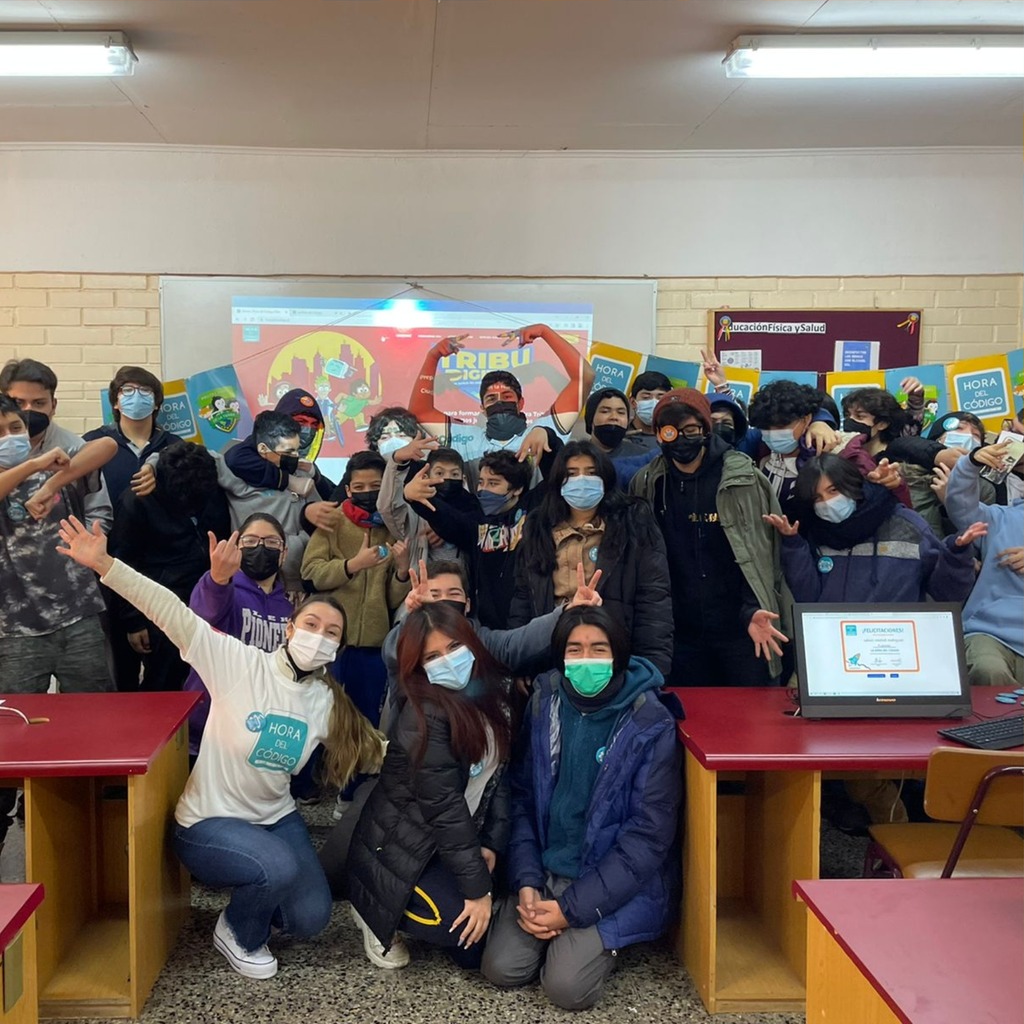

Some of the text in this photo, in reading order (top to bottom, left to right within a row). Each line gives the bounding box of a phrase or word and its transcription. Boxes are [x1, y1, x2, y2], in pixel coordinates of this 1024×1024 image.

[444, 369, 487, 383] DIGI
[595, 363, 625, 379] HORA
[963, 377, 998, 391] HORA
[962, 395, 1004, 411] CÓDIGO
[161, 418, 192, 432] ÓDIGO
[268, 721, 302, 742] HORA
[274, 738, 288, 750] DEL
[255, 747, 297, 767] CÓDIGO
